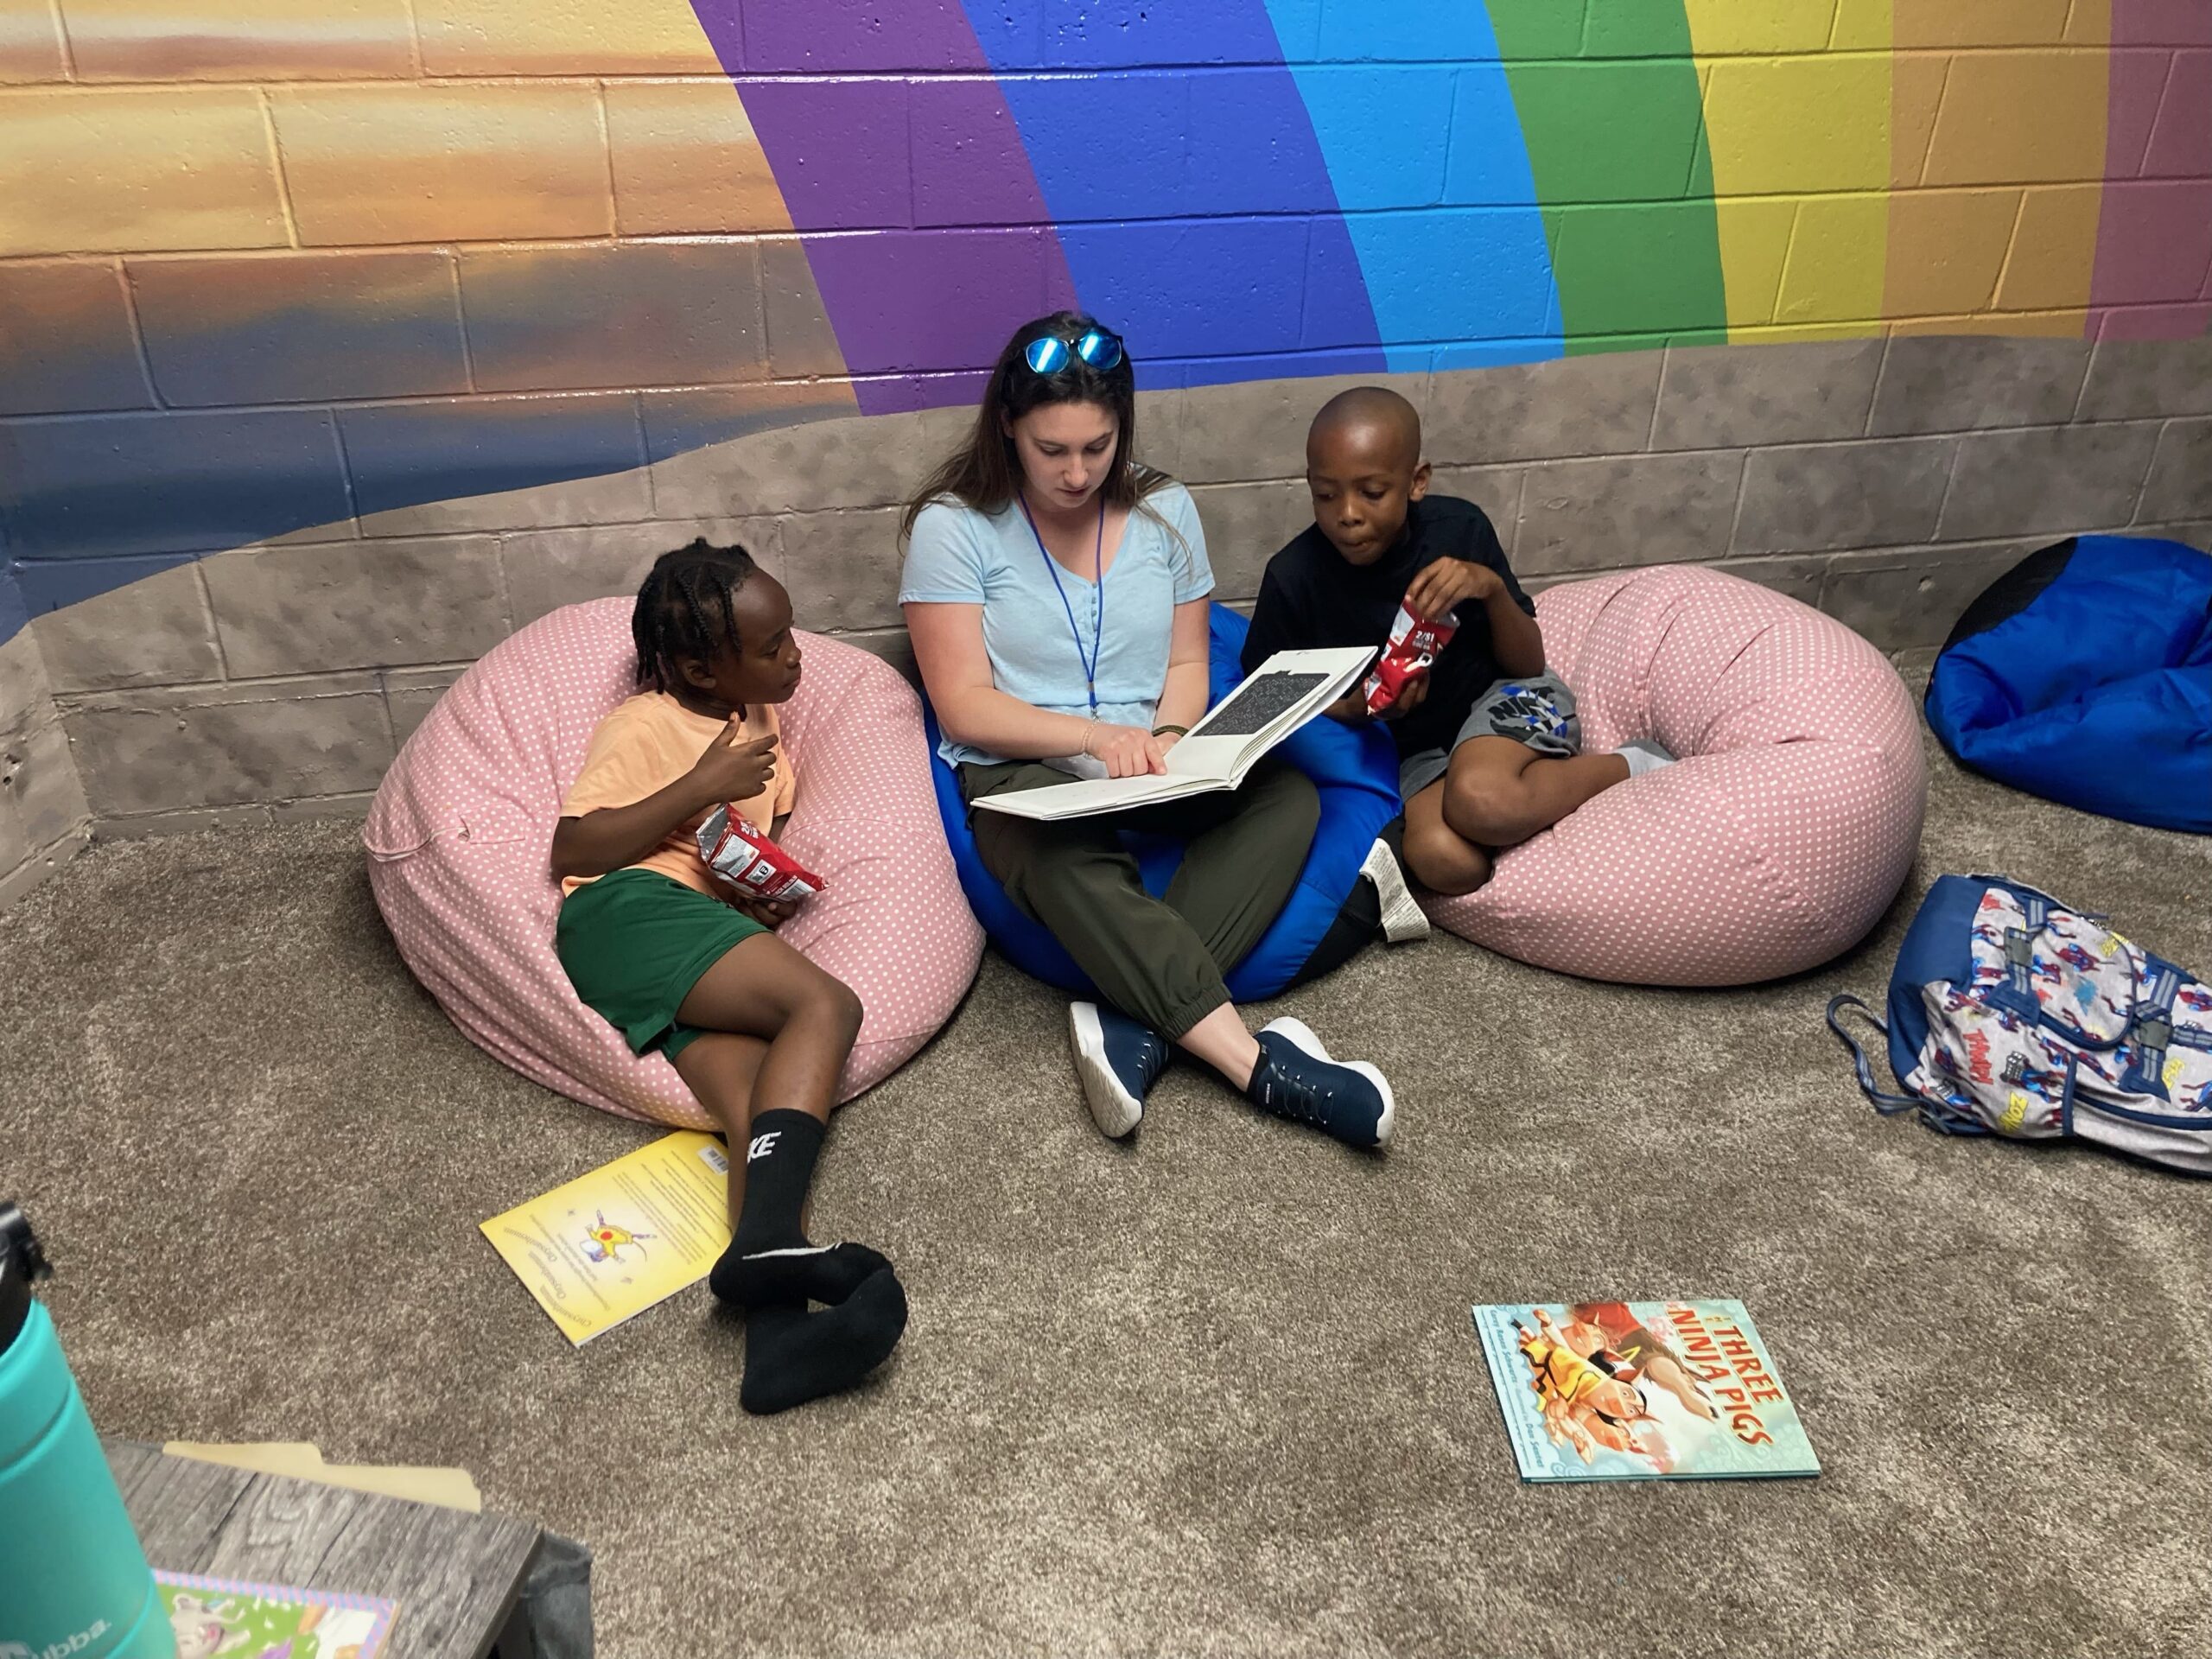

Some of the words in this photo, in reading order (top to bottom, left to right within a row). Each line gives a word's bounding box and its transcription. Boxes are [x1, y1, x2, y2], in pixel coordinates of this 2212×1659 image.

[1667, 1309, 1732, 1382] NINJA
[1713, 1388, 1774, 1446] PIGS
[1713, 1325, 1784, 1404] THREE
